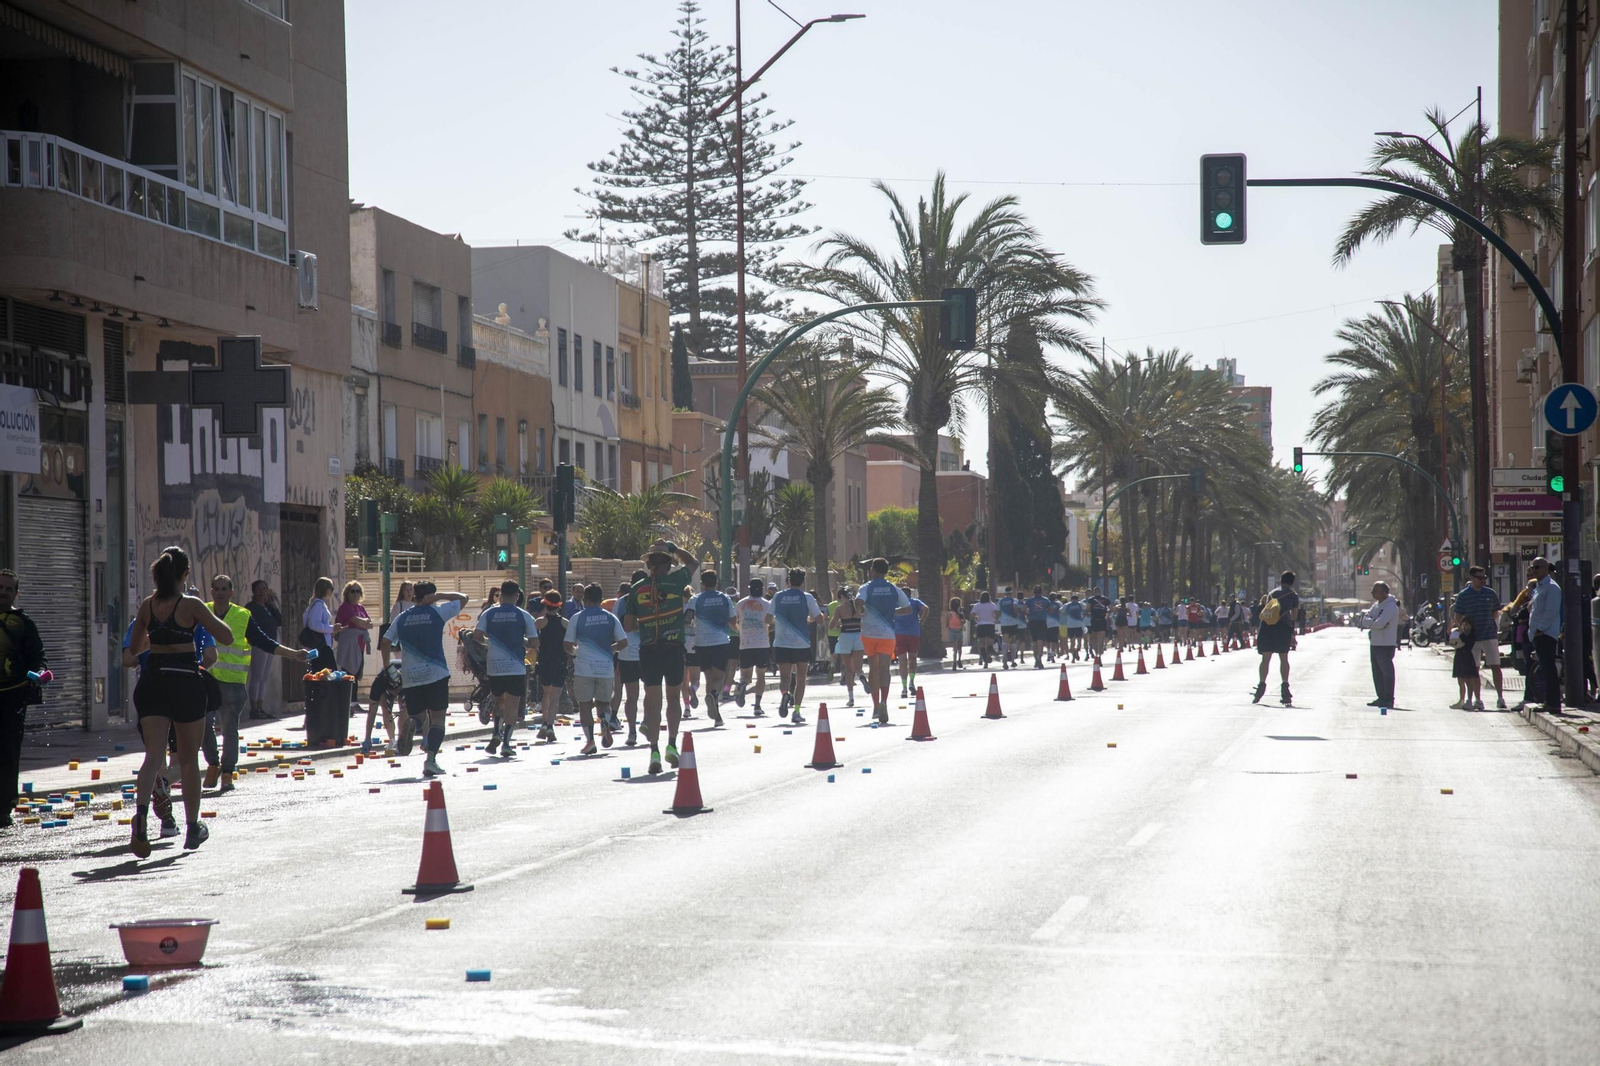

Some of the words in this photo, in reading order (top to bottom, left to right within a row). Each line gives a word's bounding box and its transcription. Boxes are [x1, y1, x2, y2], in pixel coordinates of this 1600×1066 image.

[1510, 519, 1534, 527] litoral
[1494, 527, 1519, 535] playas
[1522, 548, 1537, 556] LOFT
